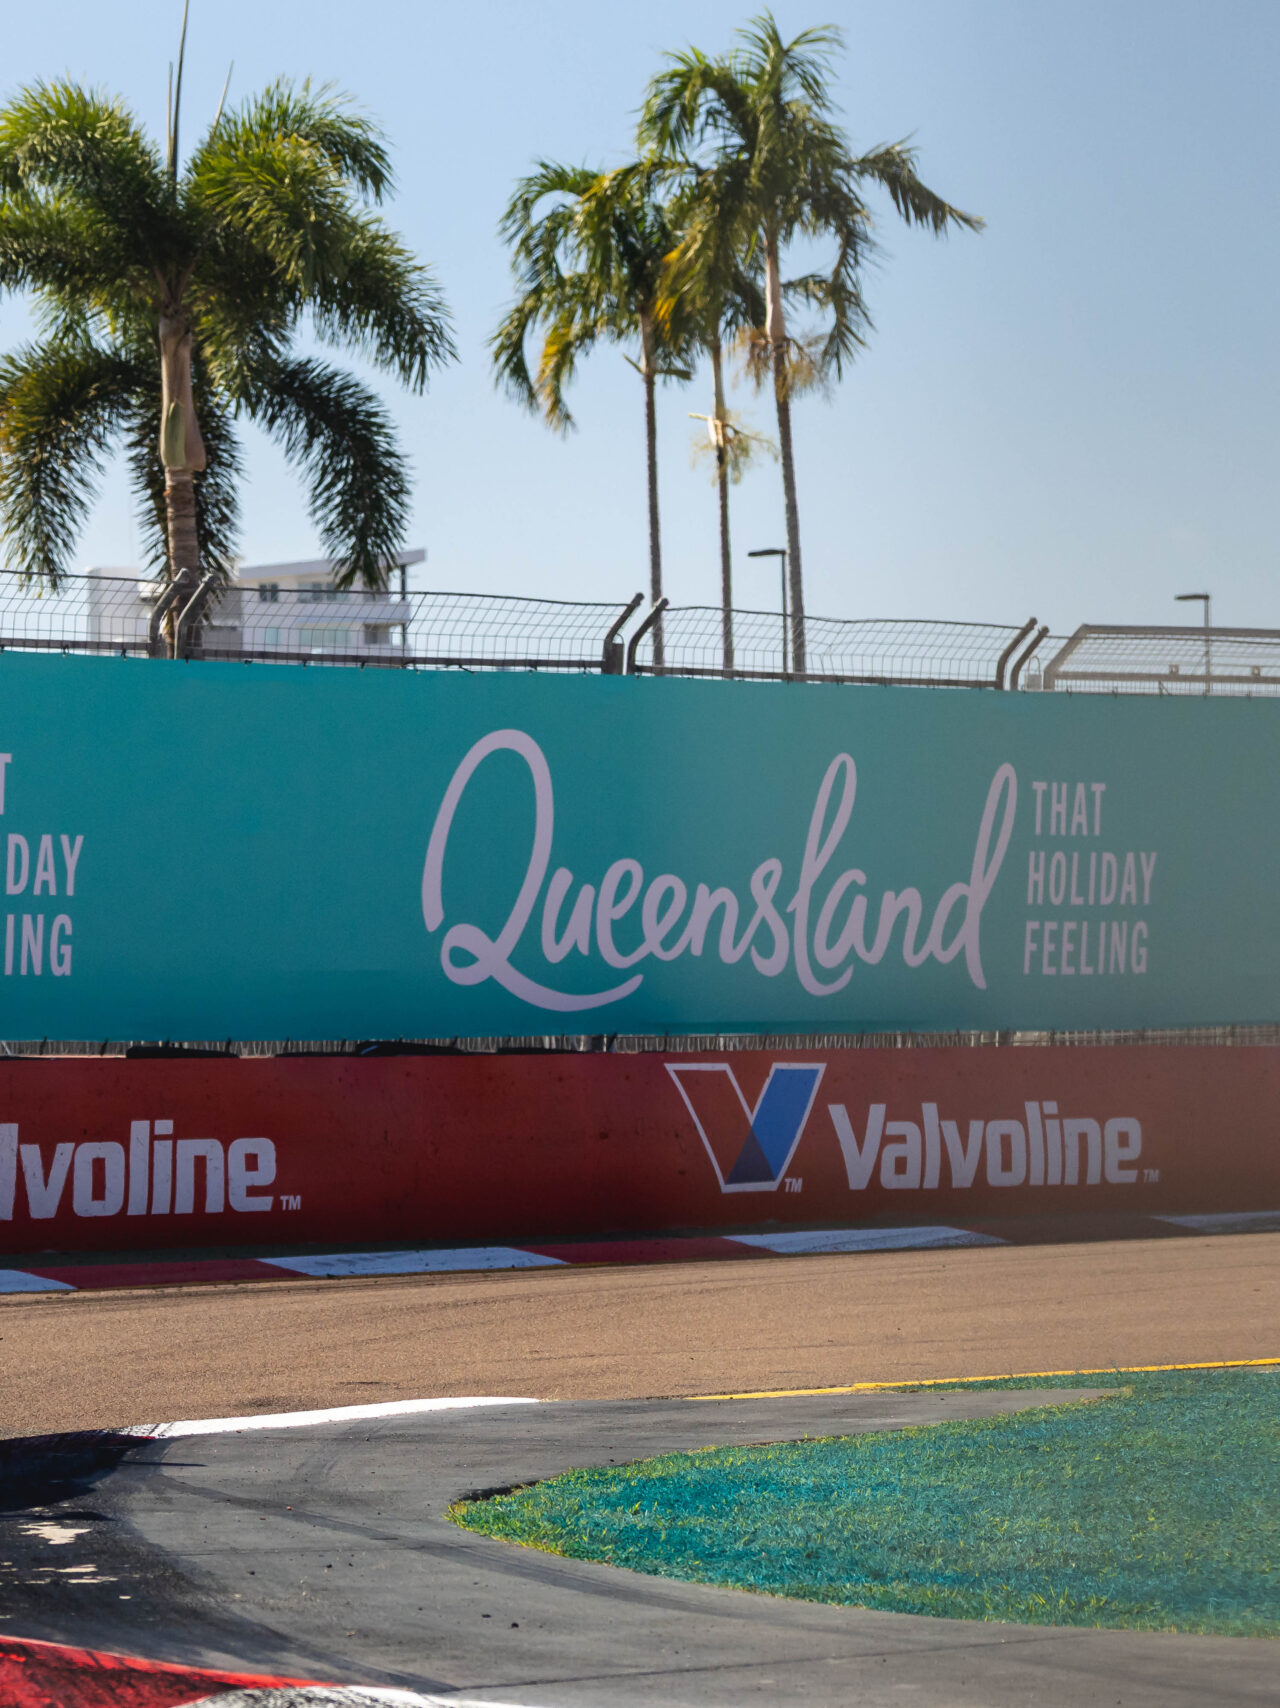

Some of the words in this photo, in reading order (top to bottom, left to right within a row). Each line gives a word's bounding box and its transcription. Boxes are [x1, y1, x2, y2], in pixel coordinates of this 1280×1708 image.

[1032, 781, 1106, 837] THAT
[422, 729, 1018, 1011] Queensland
[1026, 851, 1158, 906] HOLIDAY
[1023, 920, 1148, 976] FEELING
[828, 1101, 1143, 1190] Valvoline
[280, 1195, 301, 1211] TM
